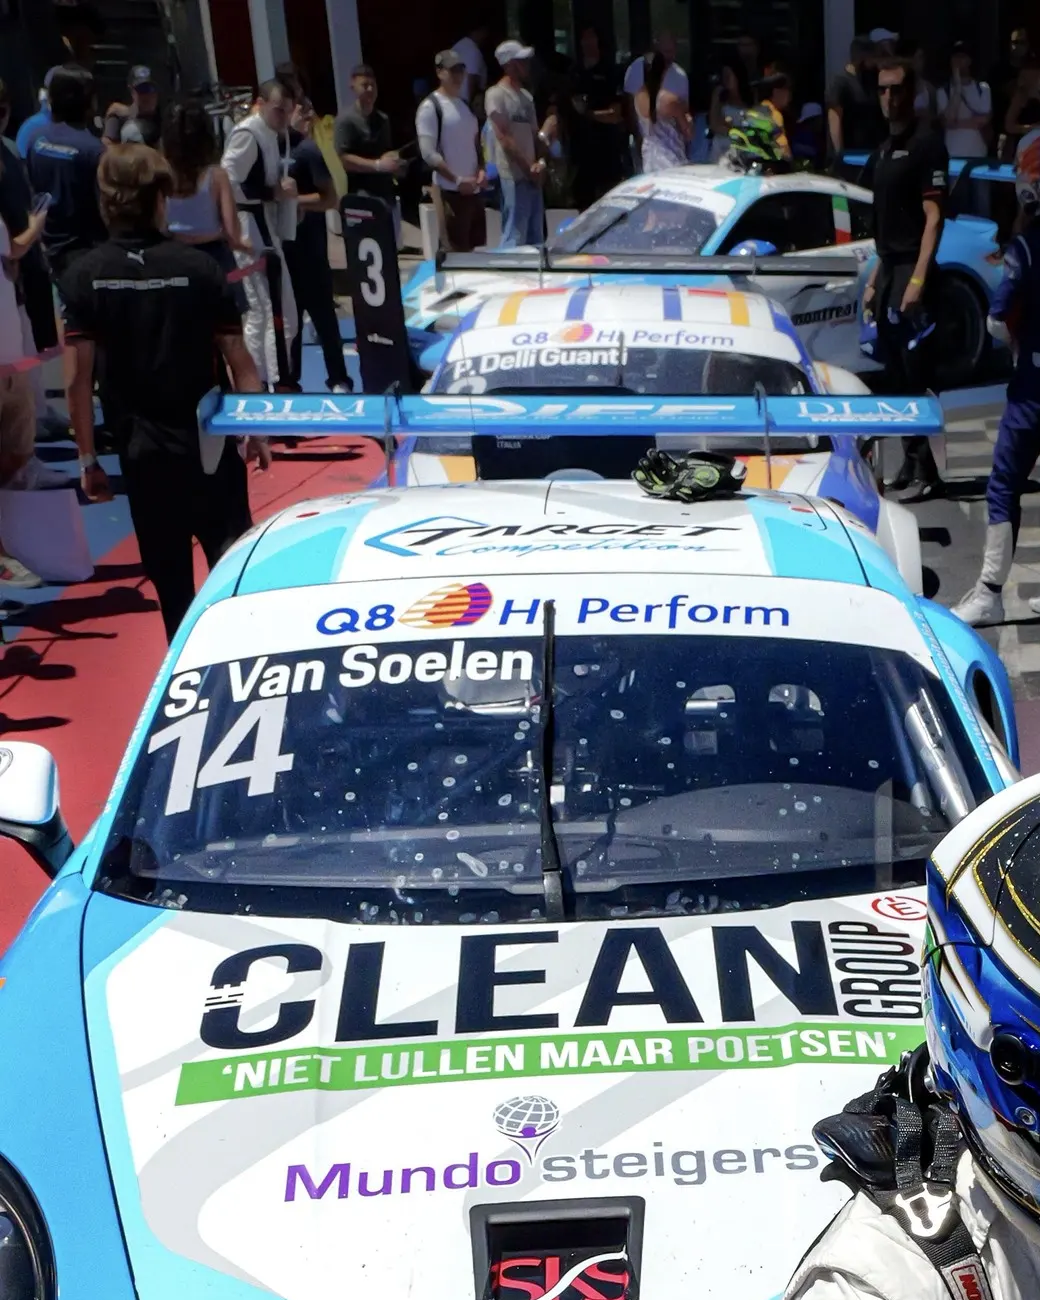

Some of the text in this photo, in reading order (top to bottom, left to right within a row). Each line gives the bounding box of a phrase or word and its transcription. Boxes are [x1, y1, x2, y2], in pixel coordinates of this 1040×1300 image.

[358, 237, 386, 308] 3
[512, 331, 549, 347] Q8
[633, 329, 735, 347] Perform
[452, 347, 628, 381] P. Delli Guanti
[227, 399, 366, 418] DLM
[798, 400, 920, 418] DLM
[401, 523, 743, 547] TARGET
[436, 537, 742, 558] Competition
[315, 594, 790, 636] Q8 H Perform
[164, 669, 210, 719] S.
[227, 656, 323, 702] Van
[338, 640, 534, 689] Soelen
[147, 695, 294, 817] 14
[200, 919, 840, 1050] CLEAN
[828, 920, 924, 1019] GROUP
[354, 1043, 525, 1084] LULLEN
[540, 1037, 674, 1070] MAAR
[284, 1140, 820, 1203] Mundo steigers
